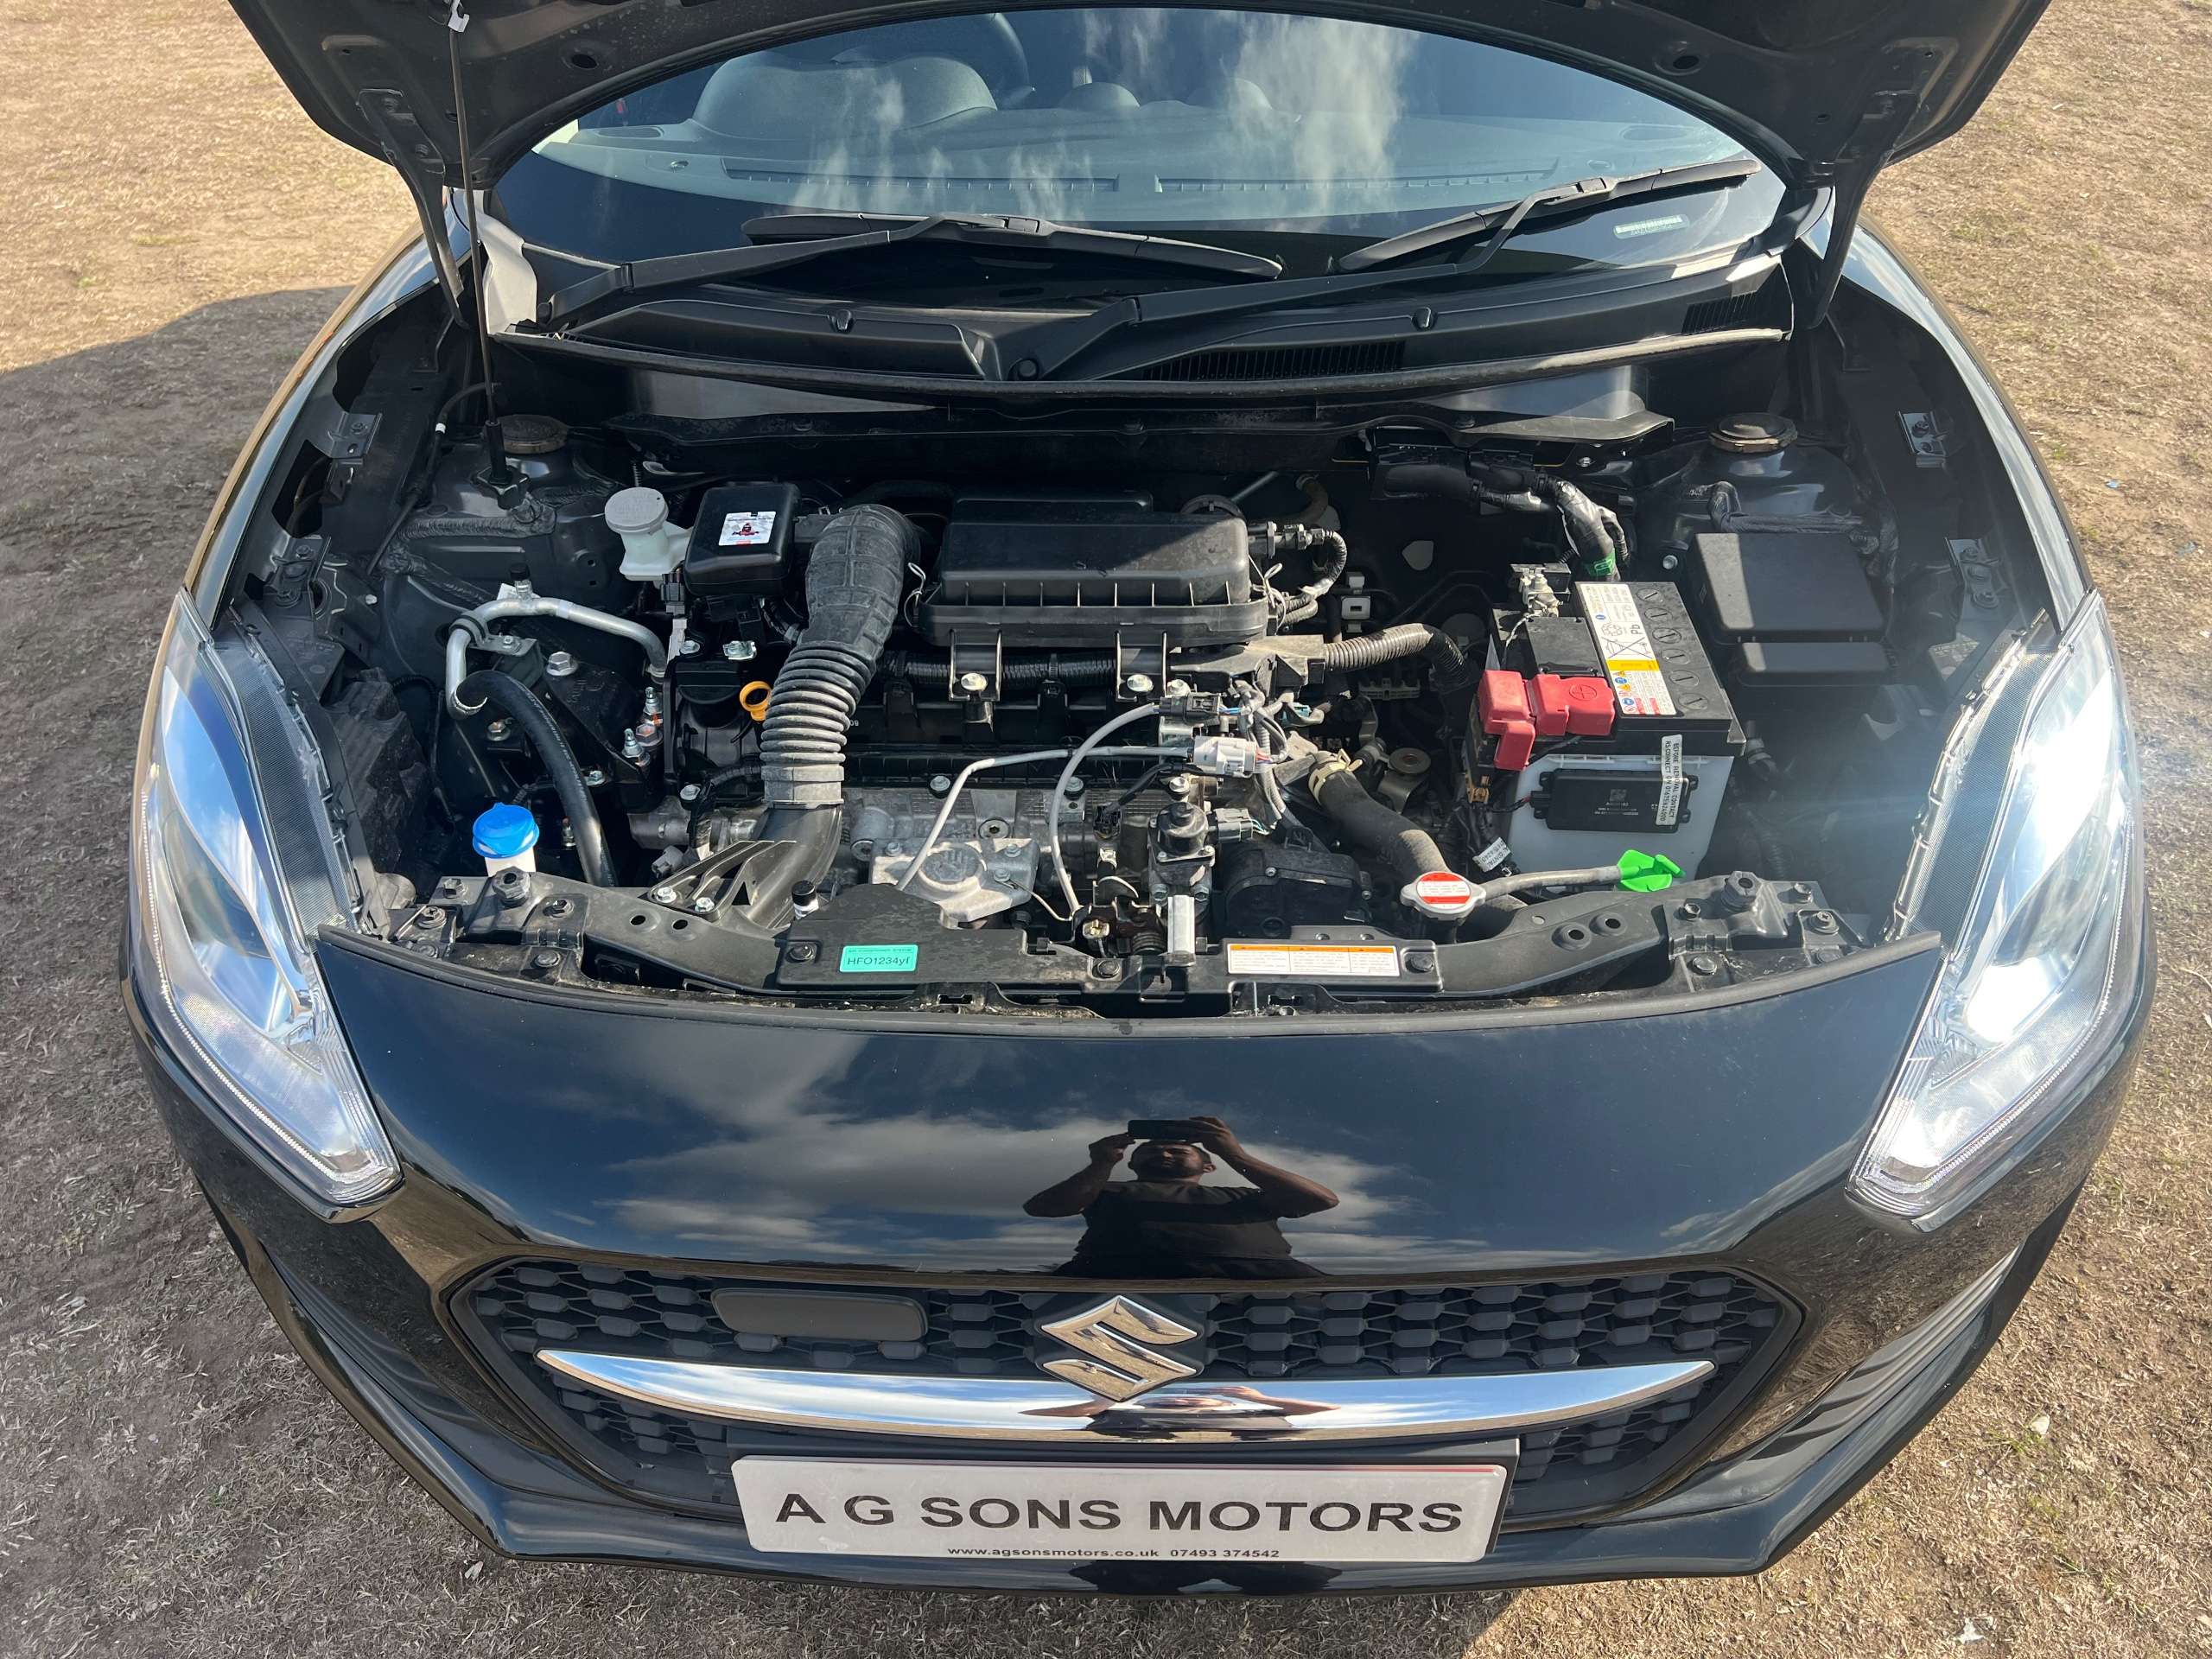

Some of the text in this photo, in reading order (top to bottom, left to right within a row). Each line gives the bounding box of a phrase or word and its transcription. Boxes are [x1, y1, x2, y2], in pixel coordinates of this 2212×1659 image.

[1630, 624, 1645, 635] Pb
[1669, 795, 1678, 818] CONTACT
[848, 957, 911, 966] HFO1234yf
[775, 1493, 1465, 1534] A G SONS MOTORS
[947, 1548, 1281, 1559] www.agsonsmotors.co.uk 07493 374542
